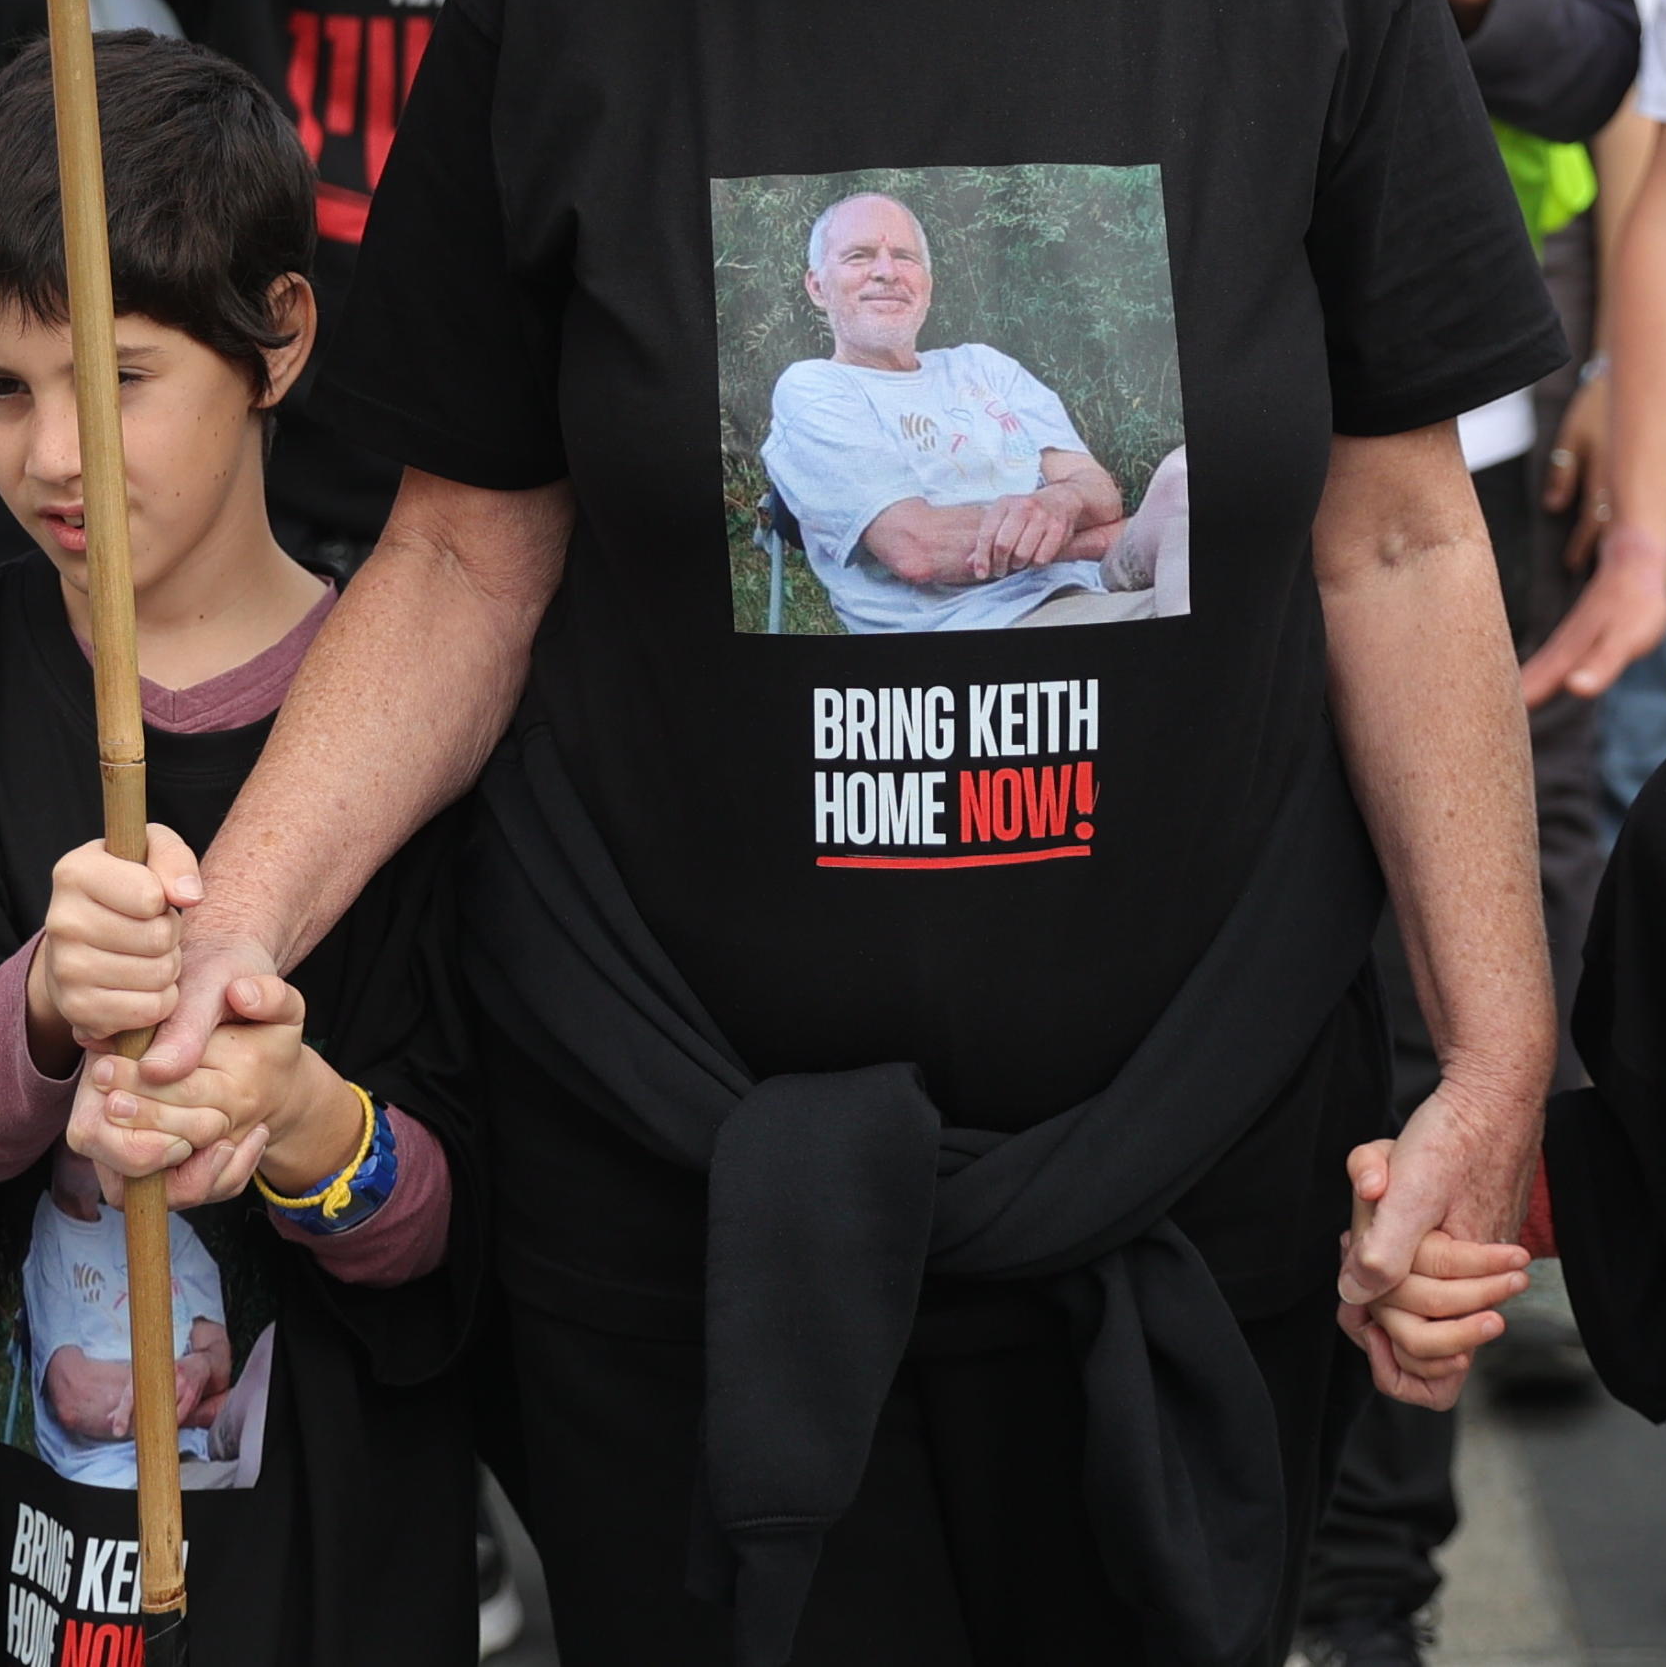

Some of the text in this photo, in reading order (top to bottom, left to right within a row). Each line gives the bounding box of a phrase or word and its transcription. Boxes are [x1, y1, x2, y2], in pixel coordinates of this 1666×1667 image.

[813, 679, 1099, 761] BRING KEITH
[814, 761, 1098, 845] HOME NOW!
[11, 1502, 189, 1615] BRING KEI
